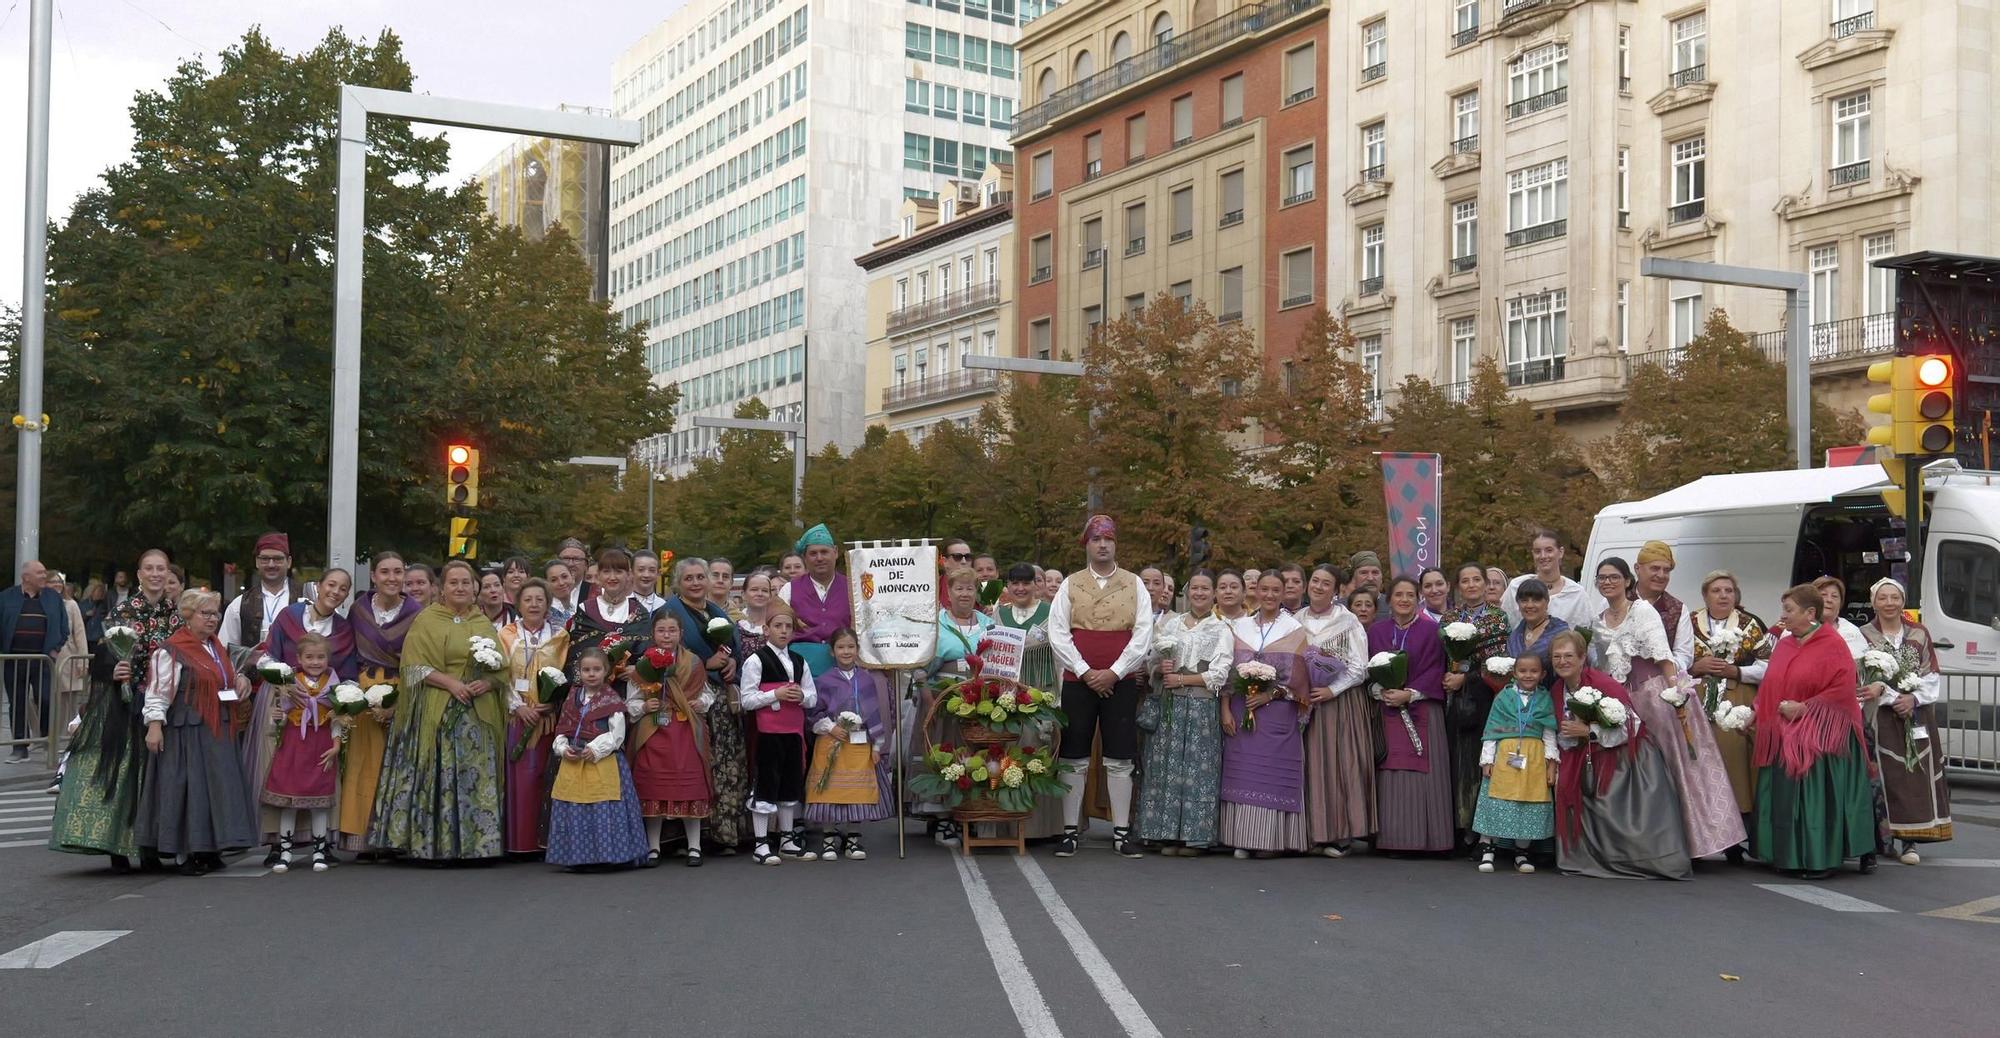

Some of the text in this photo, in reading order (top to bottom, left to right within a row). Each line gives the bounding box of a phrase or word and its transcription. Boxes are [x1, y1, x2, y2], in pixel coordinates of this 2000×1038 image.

[869, 557, 916, 568] ARANDA
[888, 570, 904, 580] DE
[878, 583, 930, 594] MONCAYO
